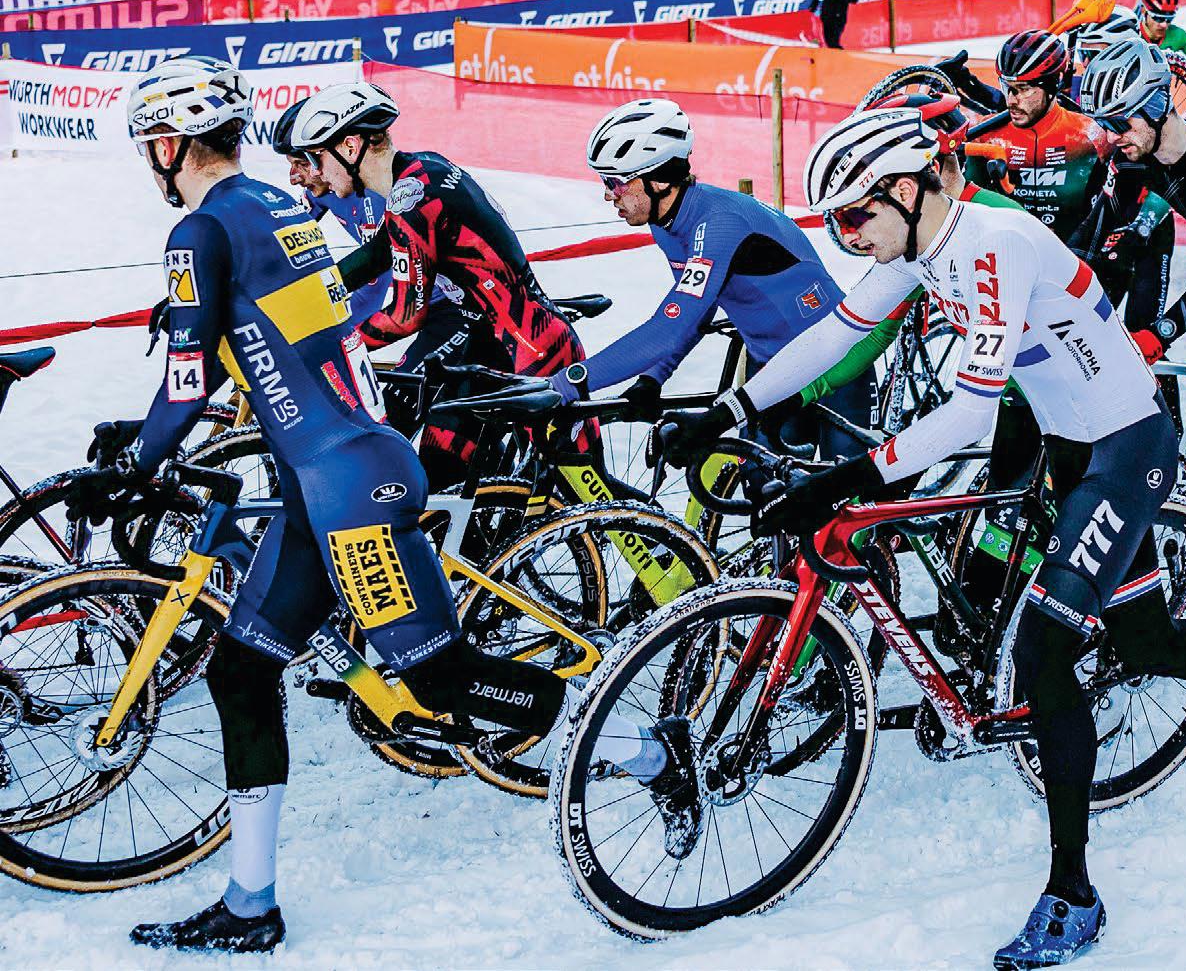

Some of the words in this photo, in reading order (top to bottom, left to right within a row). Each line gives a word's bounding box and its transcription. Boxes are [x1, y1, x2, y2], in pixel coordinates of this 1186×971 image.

[545, 10, 613, 27] GIANT
[654, 2, 715, 23] GIANT
[258, 39, 356, 65] GIANT
[413, 30, 455, 51] GIA
[81, 48, 191, 72] GIANT
[459, 27, 536, 85] ethias
[573, 38, 668, 92] ethias
[341, 100, 366, 121] LAZER
[18, 110, 98, 141] WORKWEAR
[859, 171, 875, 188] 777
[1019, 167, 1067, 186] KTM
[1013, 188, 1058, 198] KOMETA
[363, 197, 382, 225] cas
[393, 255, 408, 273] 20
[680, 268, 707, 287] 29
[974, 252, 1001, 322] 777
[973, 333, 1005, 358] 27
[1072, 337, 1102, 376] ALPHA
[234, 321, 285, 406] FIRM
[966, 363, 981, 373] DT
[981, 365, 1004, 377] SWISS
[1063, 341, 1093, 382] MOTORHOMES
[173, 368, 201, 392] 14
[1068, 499, 1125, 577] 777
[916, 533, 956, 587] UBE
[344, 542, 375, 616] CONTAINERS
[356, 537, 398, 613] MAES
[1043, 593, 1085, 623] FRISTADS
[854, 579, 937, 677] STEVENS
[469, 681, 535, 709] vermarc
[844, 660, 868, 703] SWISS
[853, 705, 869, 730] DT
[569, 802, 583, 829] DT
[570, 833, 598, 878] SWISS
